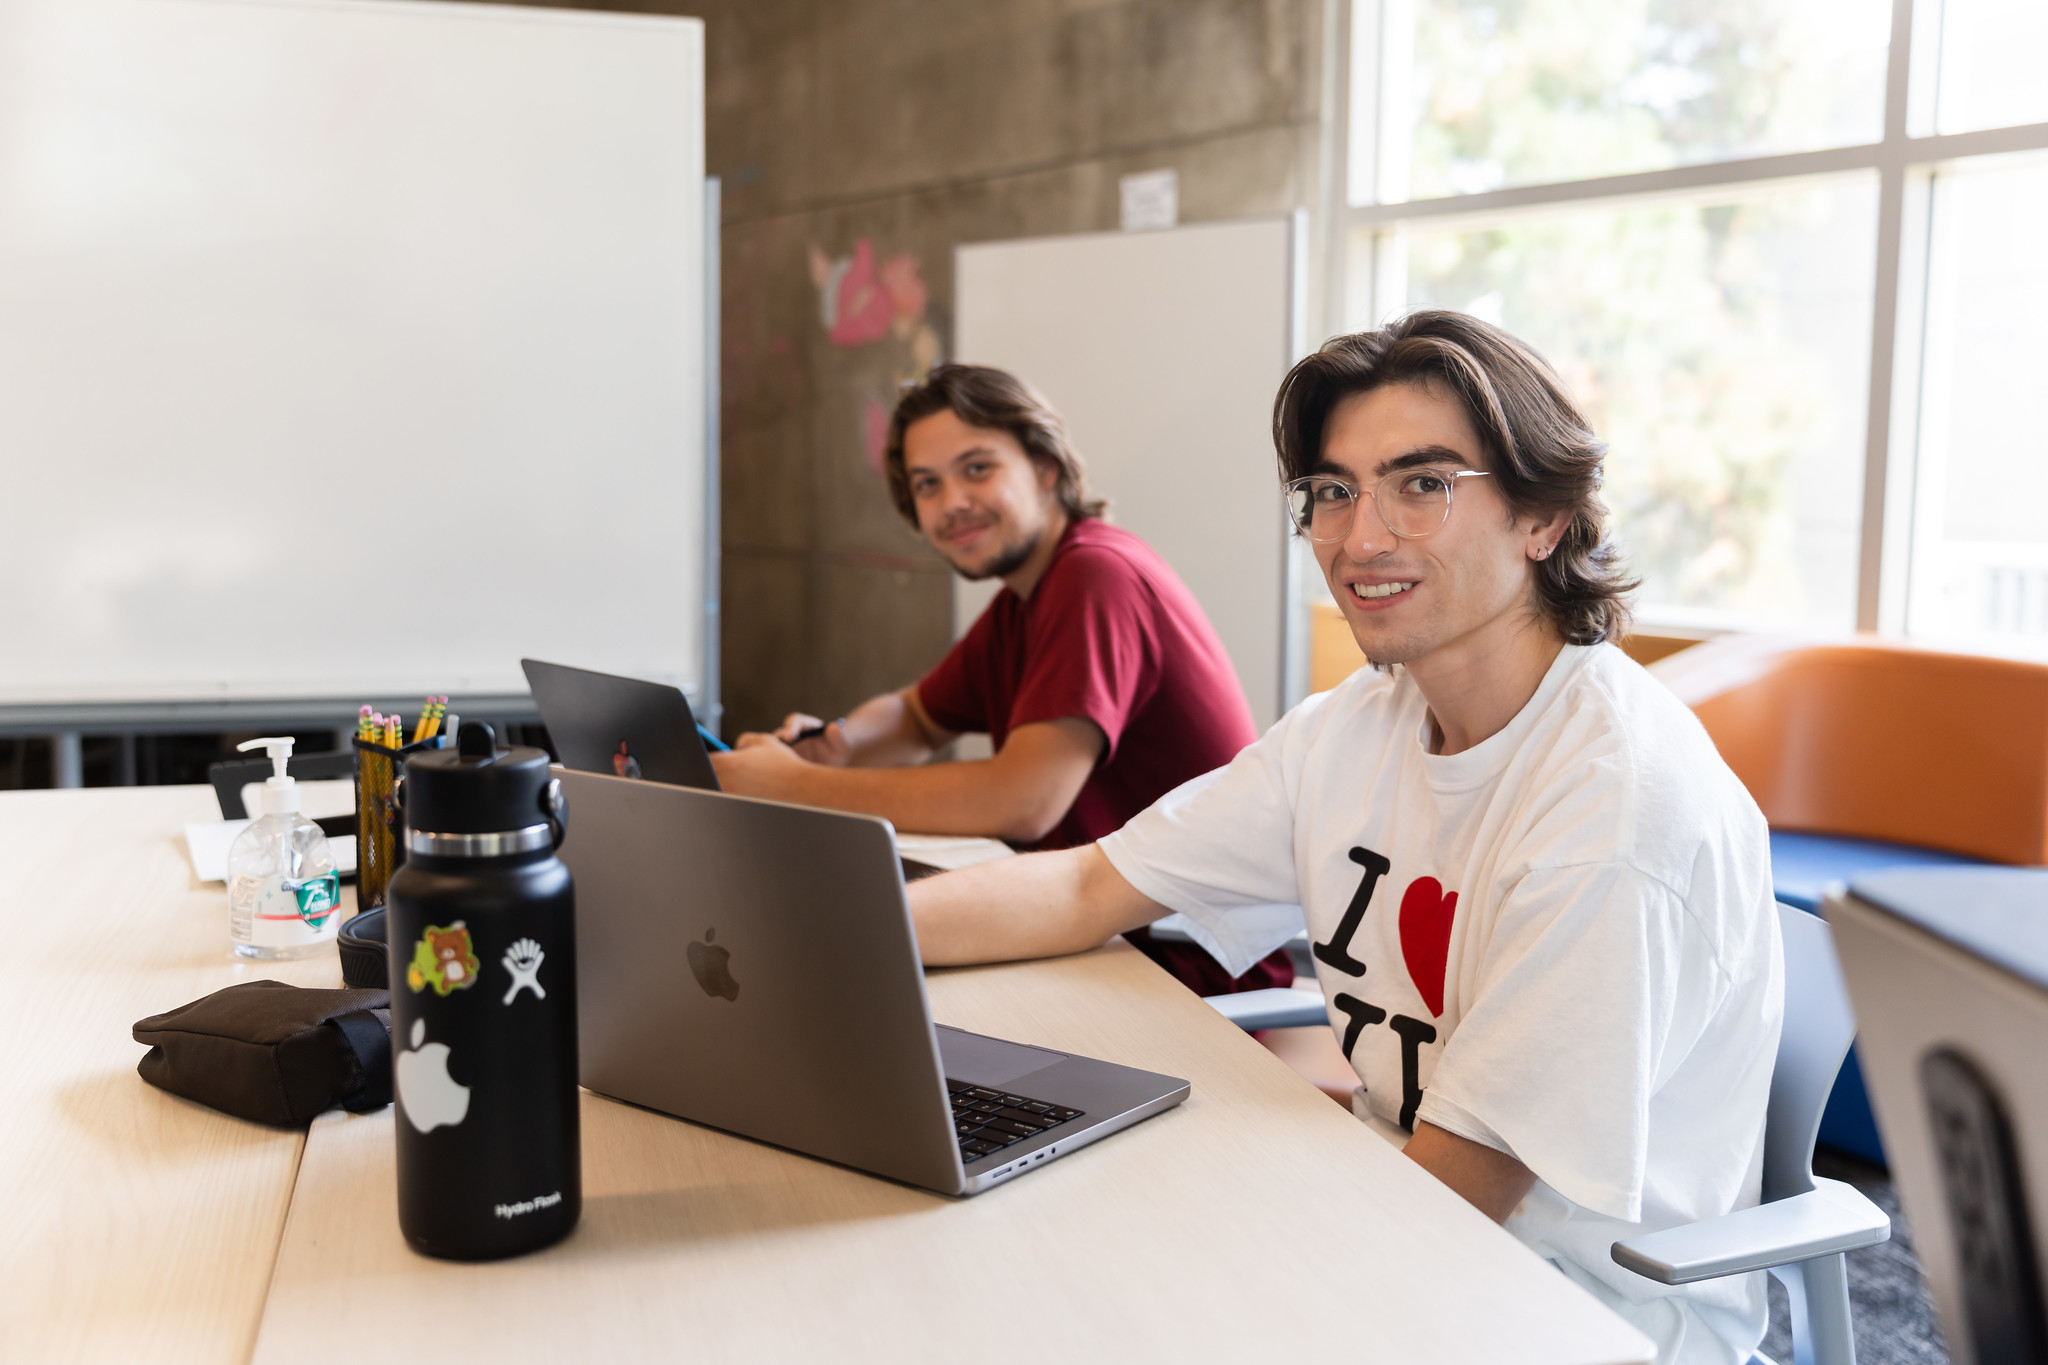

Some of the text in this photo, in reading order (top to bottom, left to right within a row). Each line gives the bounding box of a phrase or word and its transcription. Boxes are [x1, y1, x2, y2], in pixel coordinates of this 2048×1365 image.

[1312, 845, 1391, 978] I
[494, 1191, 562, 1219] Hydro Flask
